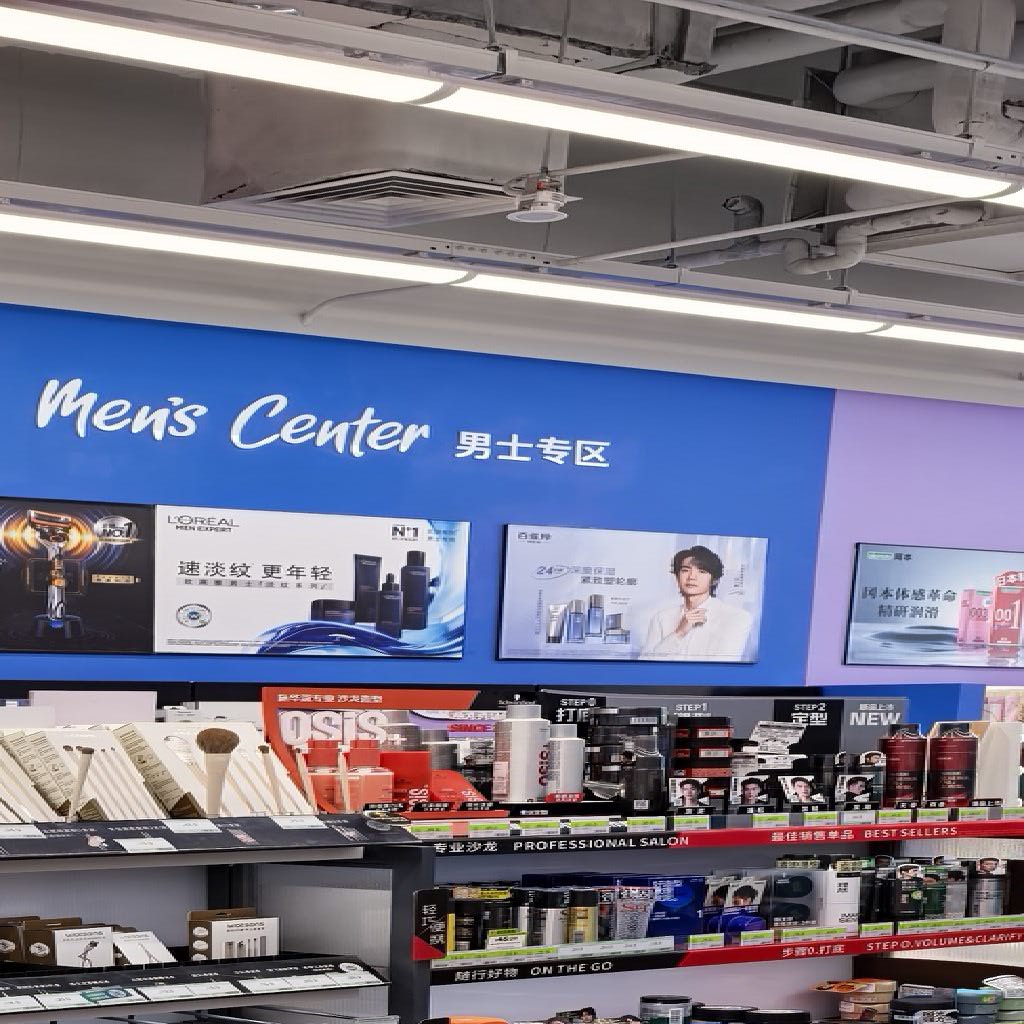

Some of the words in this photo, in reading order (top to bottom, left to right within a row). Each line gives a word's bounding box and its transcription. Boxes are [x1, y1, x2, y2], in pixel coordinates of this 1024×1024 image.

[36, 378, 208, 441] Men's
[230, 394, 430, 458] Center
[455, 430, 610, 468] 男士专区
[177, 560, 252, 578] 速淡纹
[261, 563, 333, 581] 更年轻
[791, 711, 828, 727] 定型
[849, 712, 903, 727] NEW
[864, 827, 897, 838] BEST
[900, 826, 958, 837] SELLERS
[433, 840, 499, 854] 专业沙龙
[513, 838, 636, 851] PROFESSIONAL
[639, 836, 689, 847] SALON
[866, 940, 899, 951] STEP
[454, 967, 519, 982] 随行好物
[530, 965, 554, 976] ON
[557, 963, 586, 973] THE
[590, 961, 613, 972] GO
